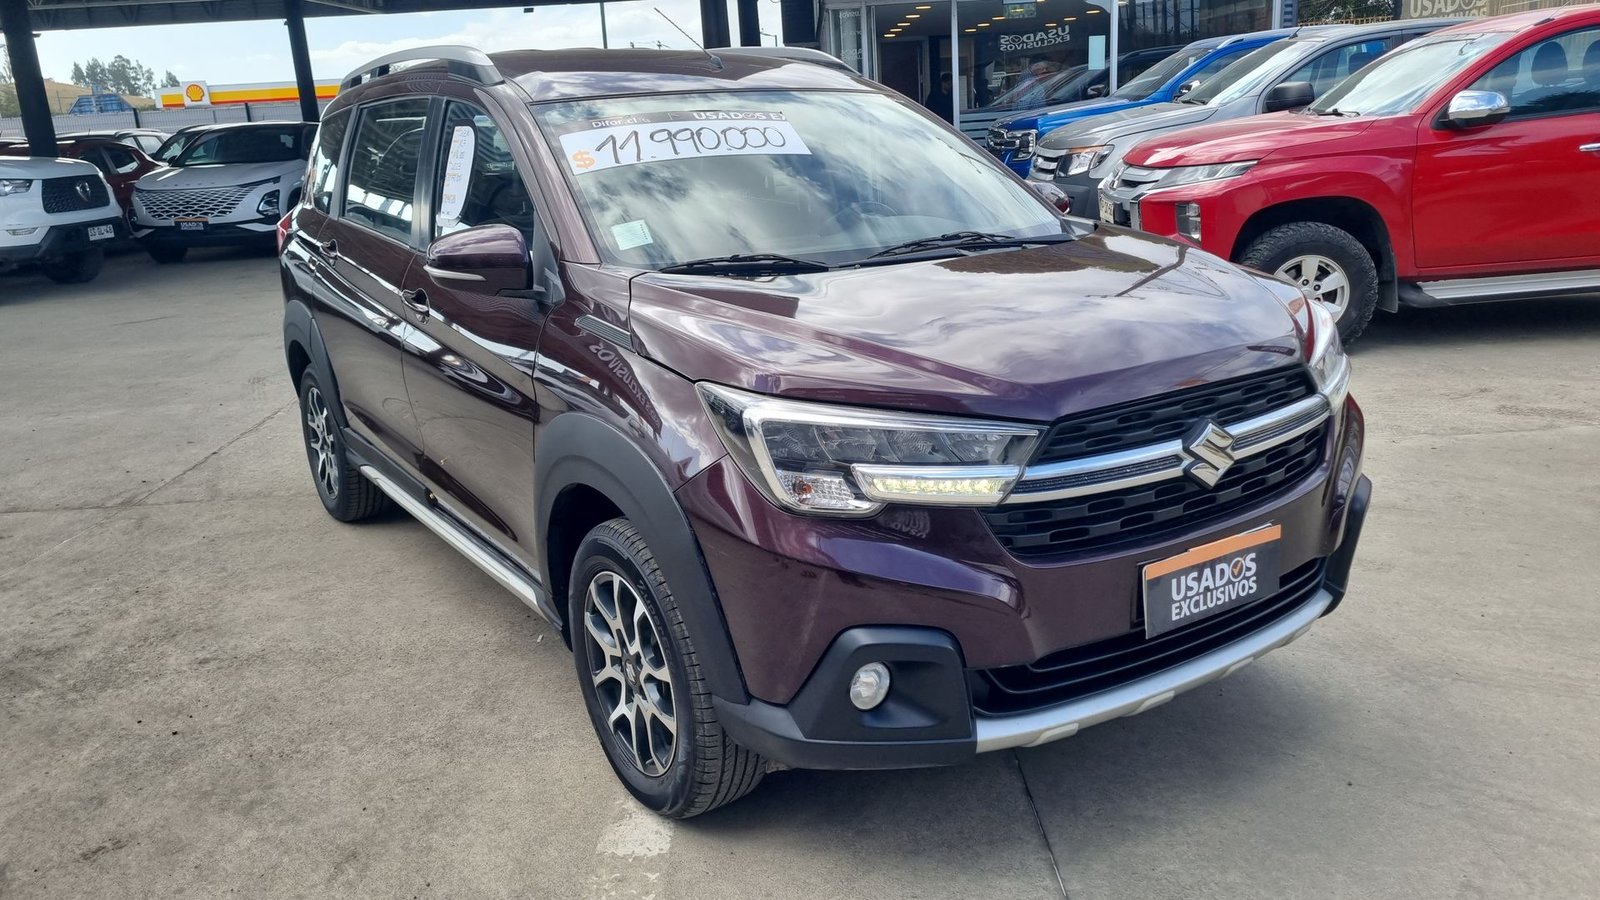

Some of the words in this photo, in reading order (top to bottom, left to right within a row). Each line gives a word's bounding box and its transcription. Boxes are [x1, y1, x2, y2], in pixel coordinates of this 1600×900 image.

[693, 111, 767, 120] USADOS
[1171, 552, 1257, 601] USADOS
[1171, 576, 1257, 621] EXCLUSIVOS
